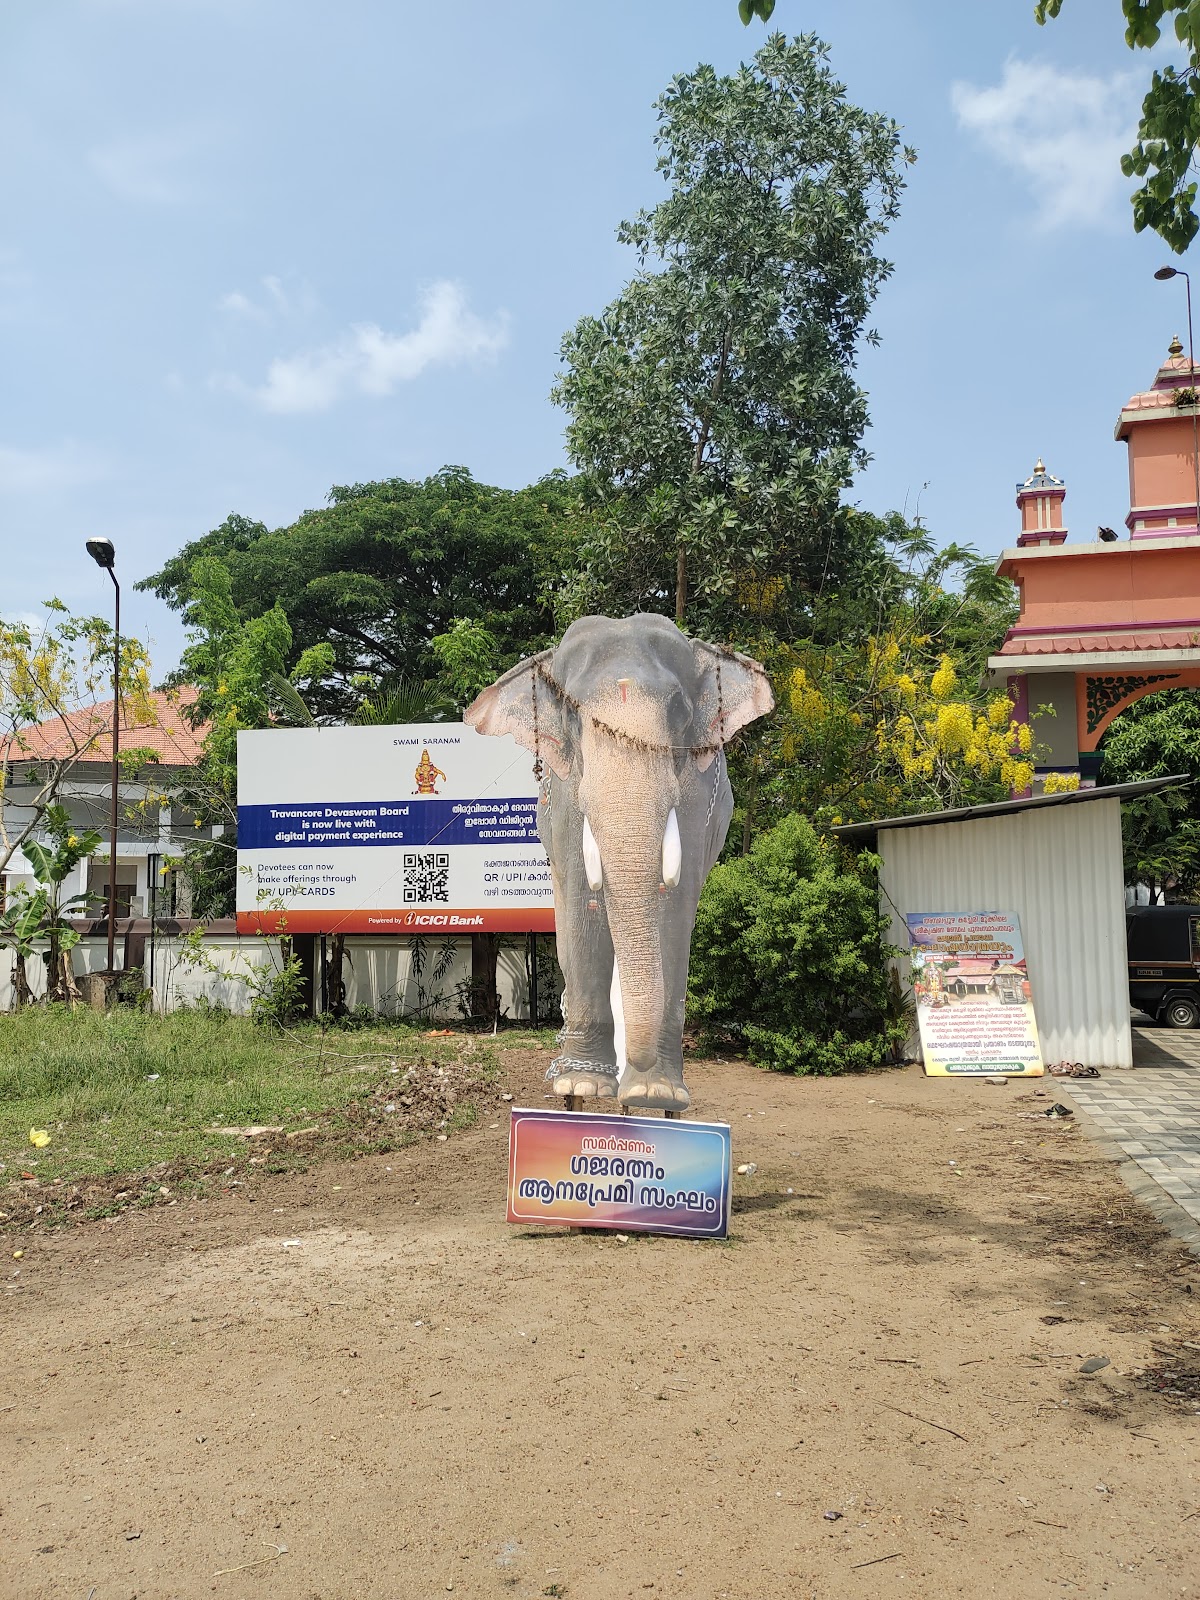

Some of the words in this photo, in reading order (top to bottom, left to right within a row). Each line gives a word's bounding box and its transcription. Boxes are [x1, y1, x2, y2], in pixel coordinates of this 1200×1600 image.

[270, 809, 323, 819] Travancore
[324, 808, 378, 817] Devaswom
[379, 806, 410, 816] Board
[301, 820, 310, 829] is
[312, 821, 333, 829] now
[335, 819, 352, 829] live
[354, 818, 376, 828] with
[275, 831, 306, 842] digital
[307, 831, 351, 842] payment
[352, 830, 404, 841] experience
[257, 863, 296, 872] Devotees
[298, 863, 314, 871] can
[316, 863, 334, 871] now
[257, 875, 281, 883] make
[283, 875, 320, 885] offerings
[322, 874, 357, 884] through
[484, 873, 499, 882] QR
[506, 873, 522, 881] UPI
[301, 887, 336, 896] CARDS
[394, 917, 402, 925] by
[415, 915, 448, 925] ICICI
[449, 915, 485, 925] Bank
[582, 1136, 656, 1154] സമർപ്പണം:
[570, 1155, 665, 1181] ഗജരത്നം
[518, 1178, 635, 1208] ആനപ്രേമി
[640, 1185, 717, 1213] സംഘം
